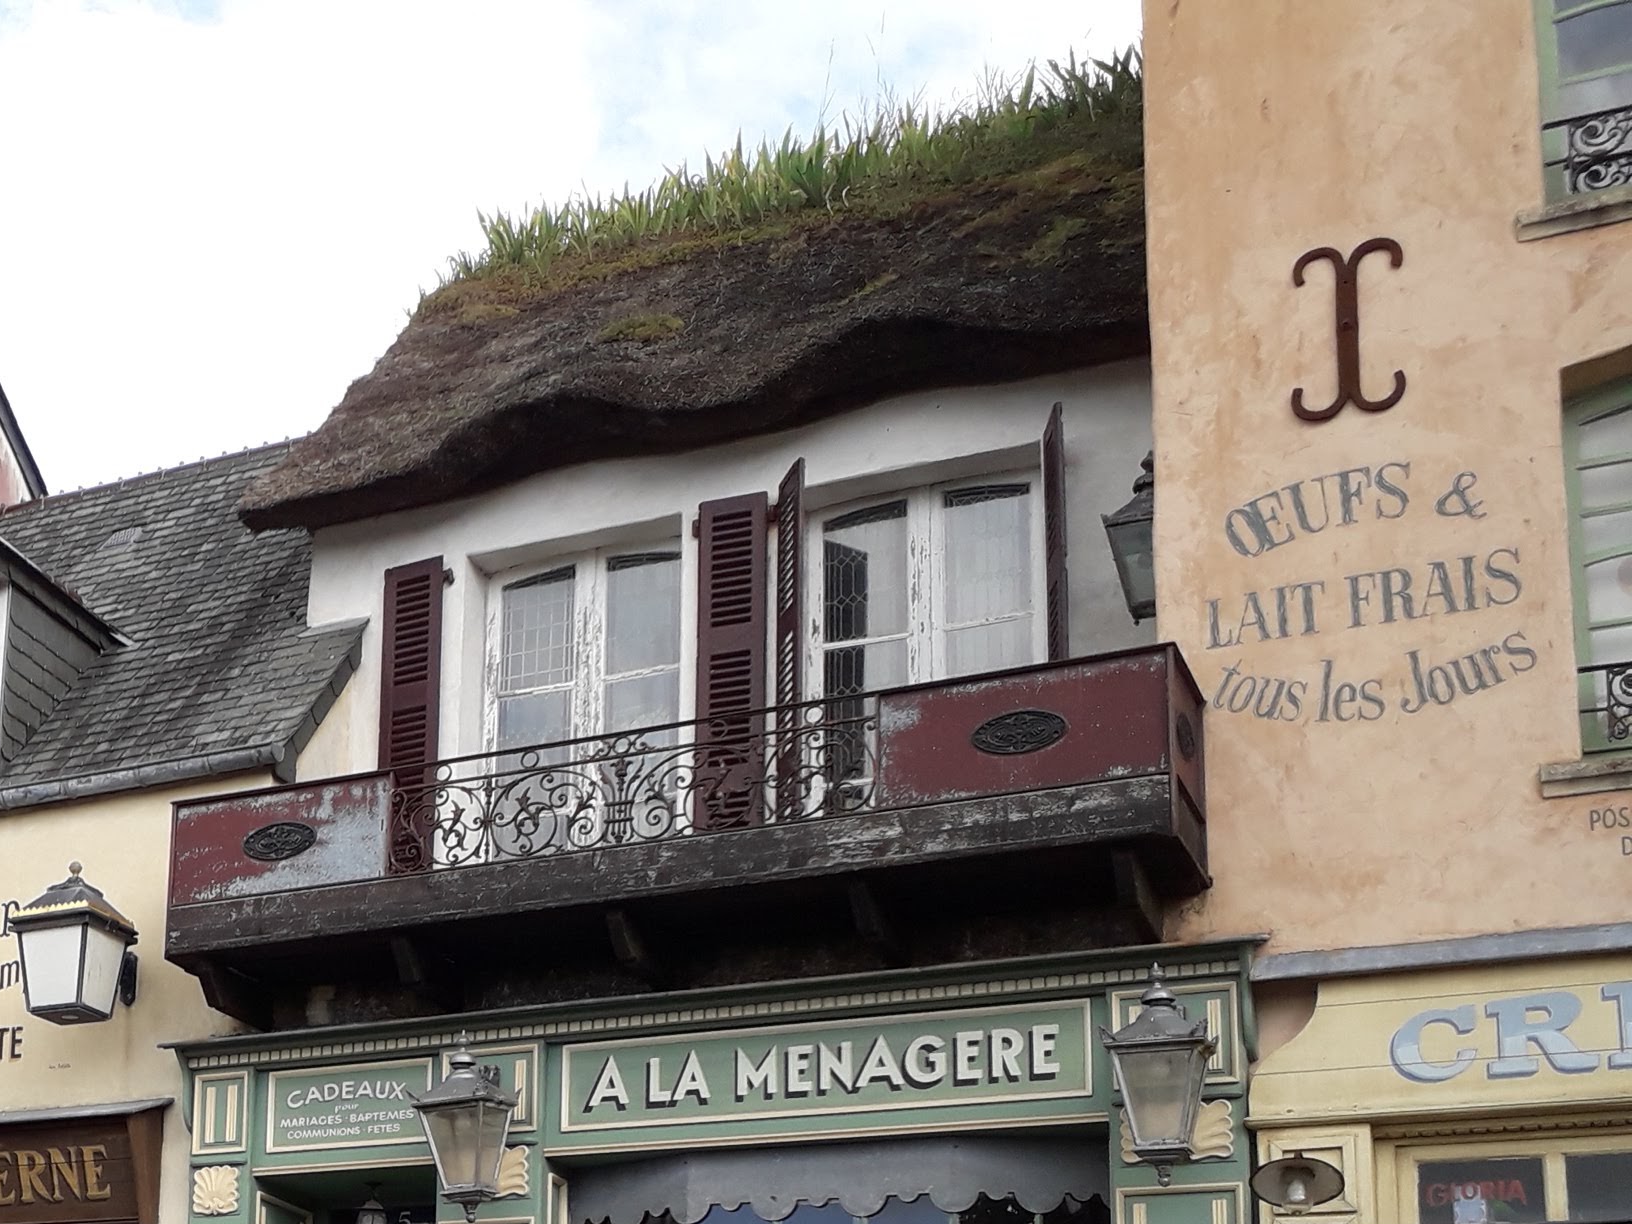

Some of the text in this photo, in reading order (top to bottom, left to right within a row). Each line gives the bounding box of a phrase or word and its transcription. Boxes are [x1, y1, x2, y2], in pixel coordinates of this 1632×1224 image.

[1225, 462, 1488, 558] ŒUFS &
[1205, 548, 1523, 651] LAIT FRAIS
[1212, 631, 1538, 723] tous les Jours
[287, 1080, 407, 1109] CADEAUX
[584, 1023, 1063, 1112] A LA MENAGERE
[280, 1109, 415, 1128] MARIAGES BAPTEMES
[287, 1123, 401, 1139] COMMUNIONS FETES
[334, 1103, 359, 1114] pour
